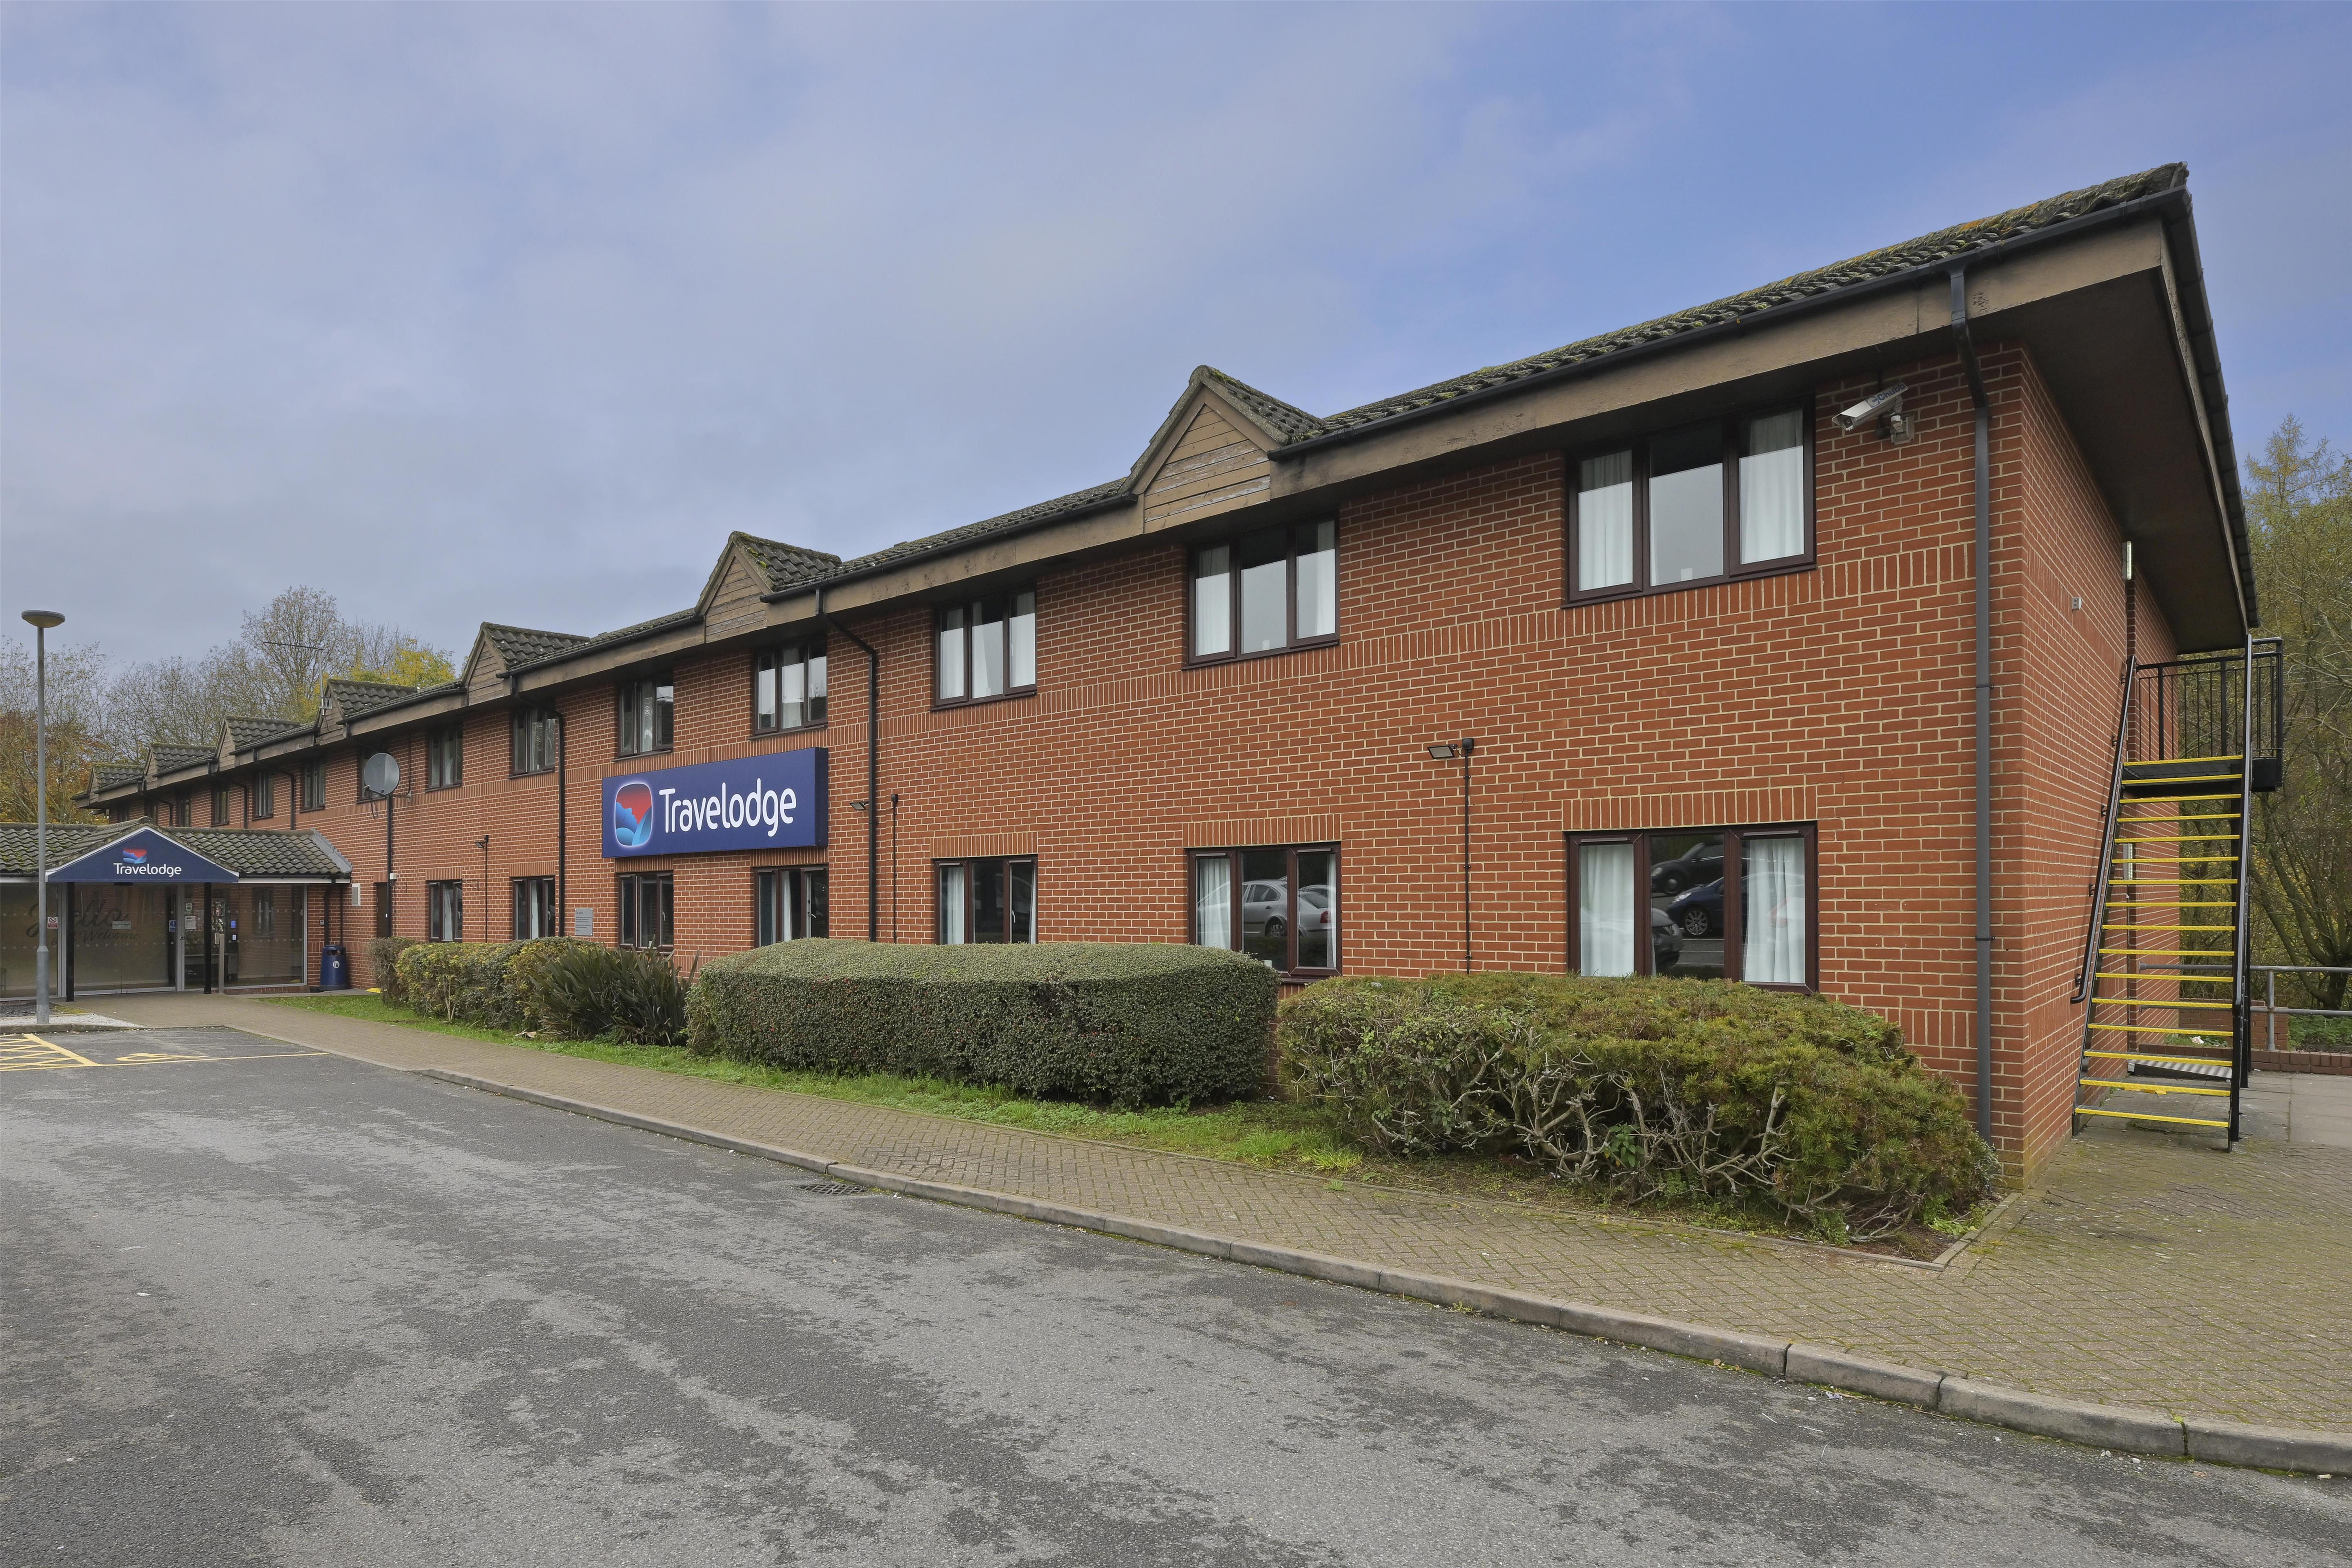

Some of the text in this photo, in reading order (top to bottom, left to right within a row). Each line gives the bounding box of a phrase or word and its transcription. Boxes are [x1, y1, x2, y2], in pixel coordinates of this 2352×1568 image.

[1877, 384, 1906, 401] Chubb
[659, 778, 796, 837] Travelodge
[113, 863, 182, 877] Travelodge
[79, 928, 141, 942] Welcome
